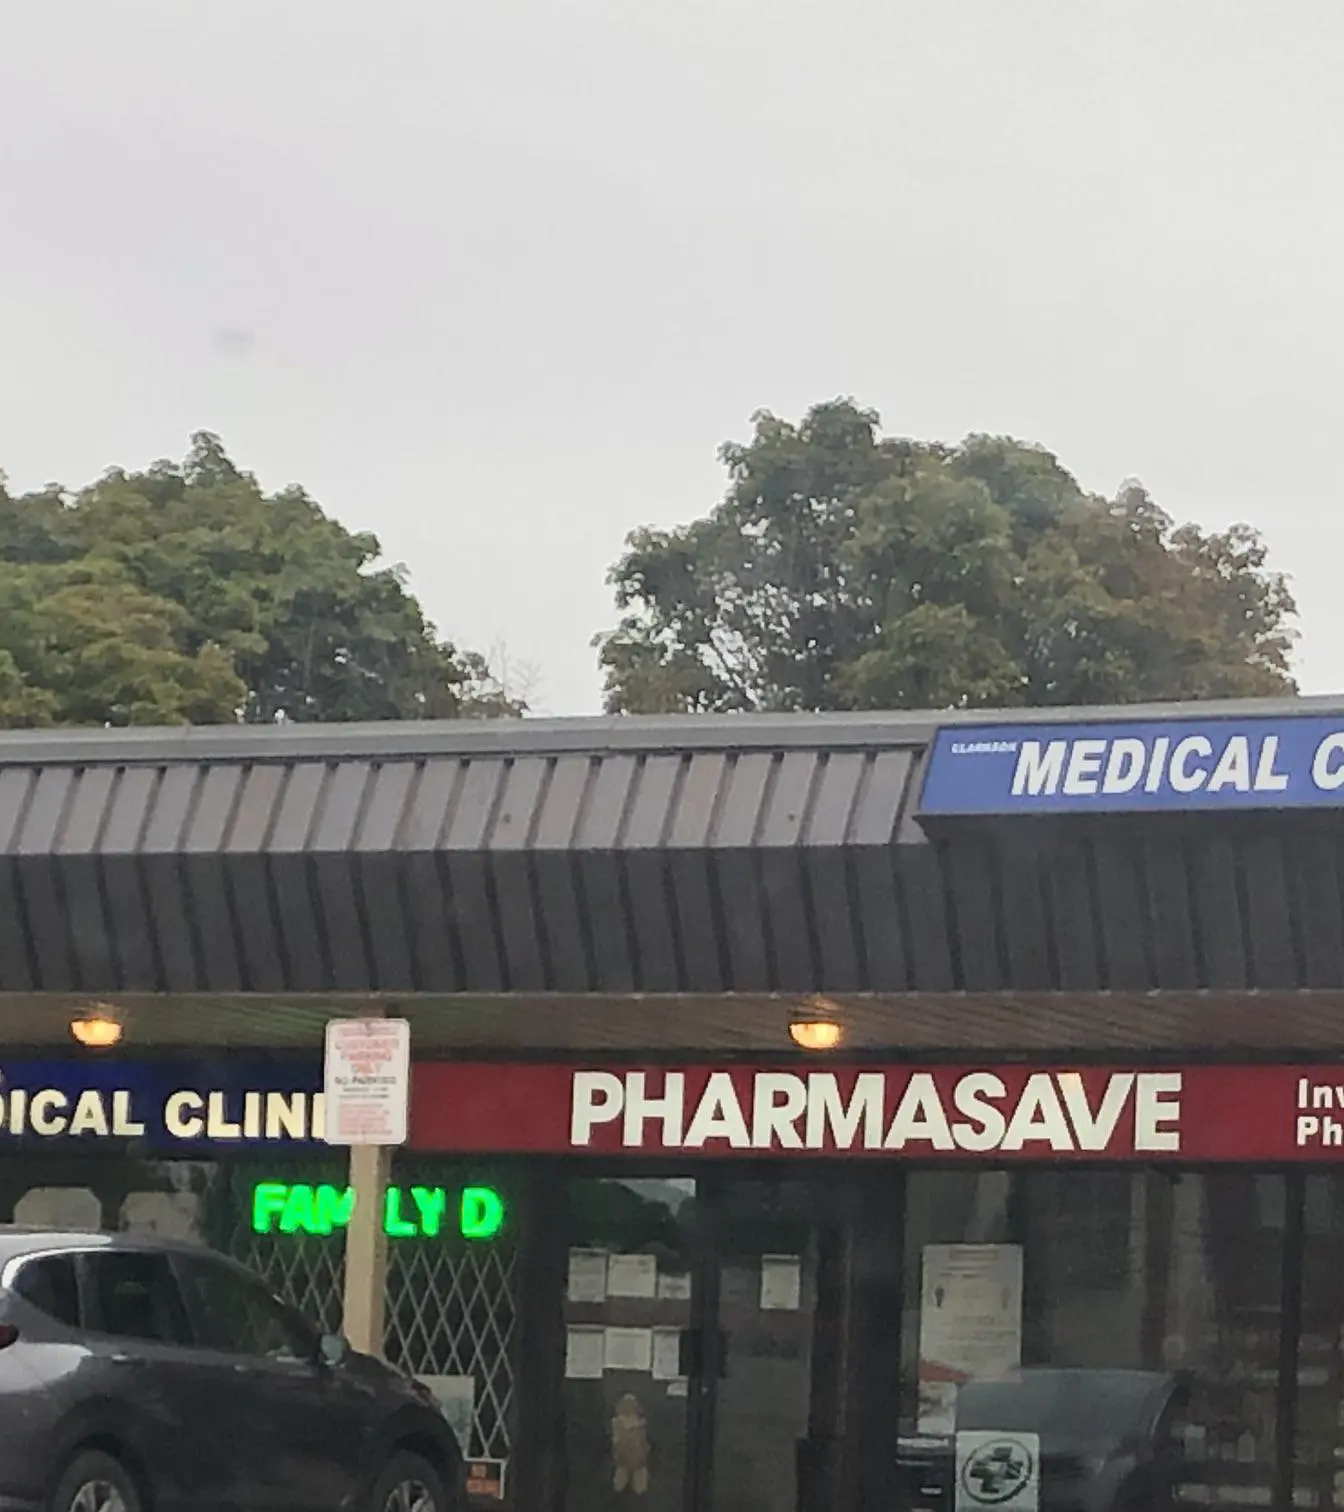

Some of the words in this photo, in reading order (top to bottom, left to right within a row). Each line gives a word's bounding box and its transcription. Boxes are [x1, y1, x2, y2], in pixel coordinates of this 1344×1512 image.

[952, 742, 1018, 754] CLARKSON
[1011, 734, 1290, 796] MEDICAL
[165, 1091, 325, 1139] CLINI
[570, 1071, 1182, 1151] PHARMASAVE
[252, 1181, 446, 1237] FAMLY
